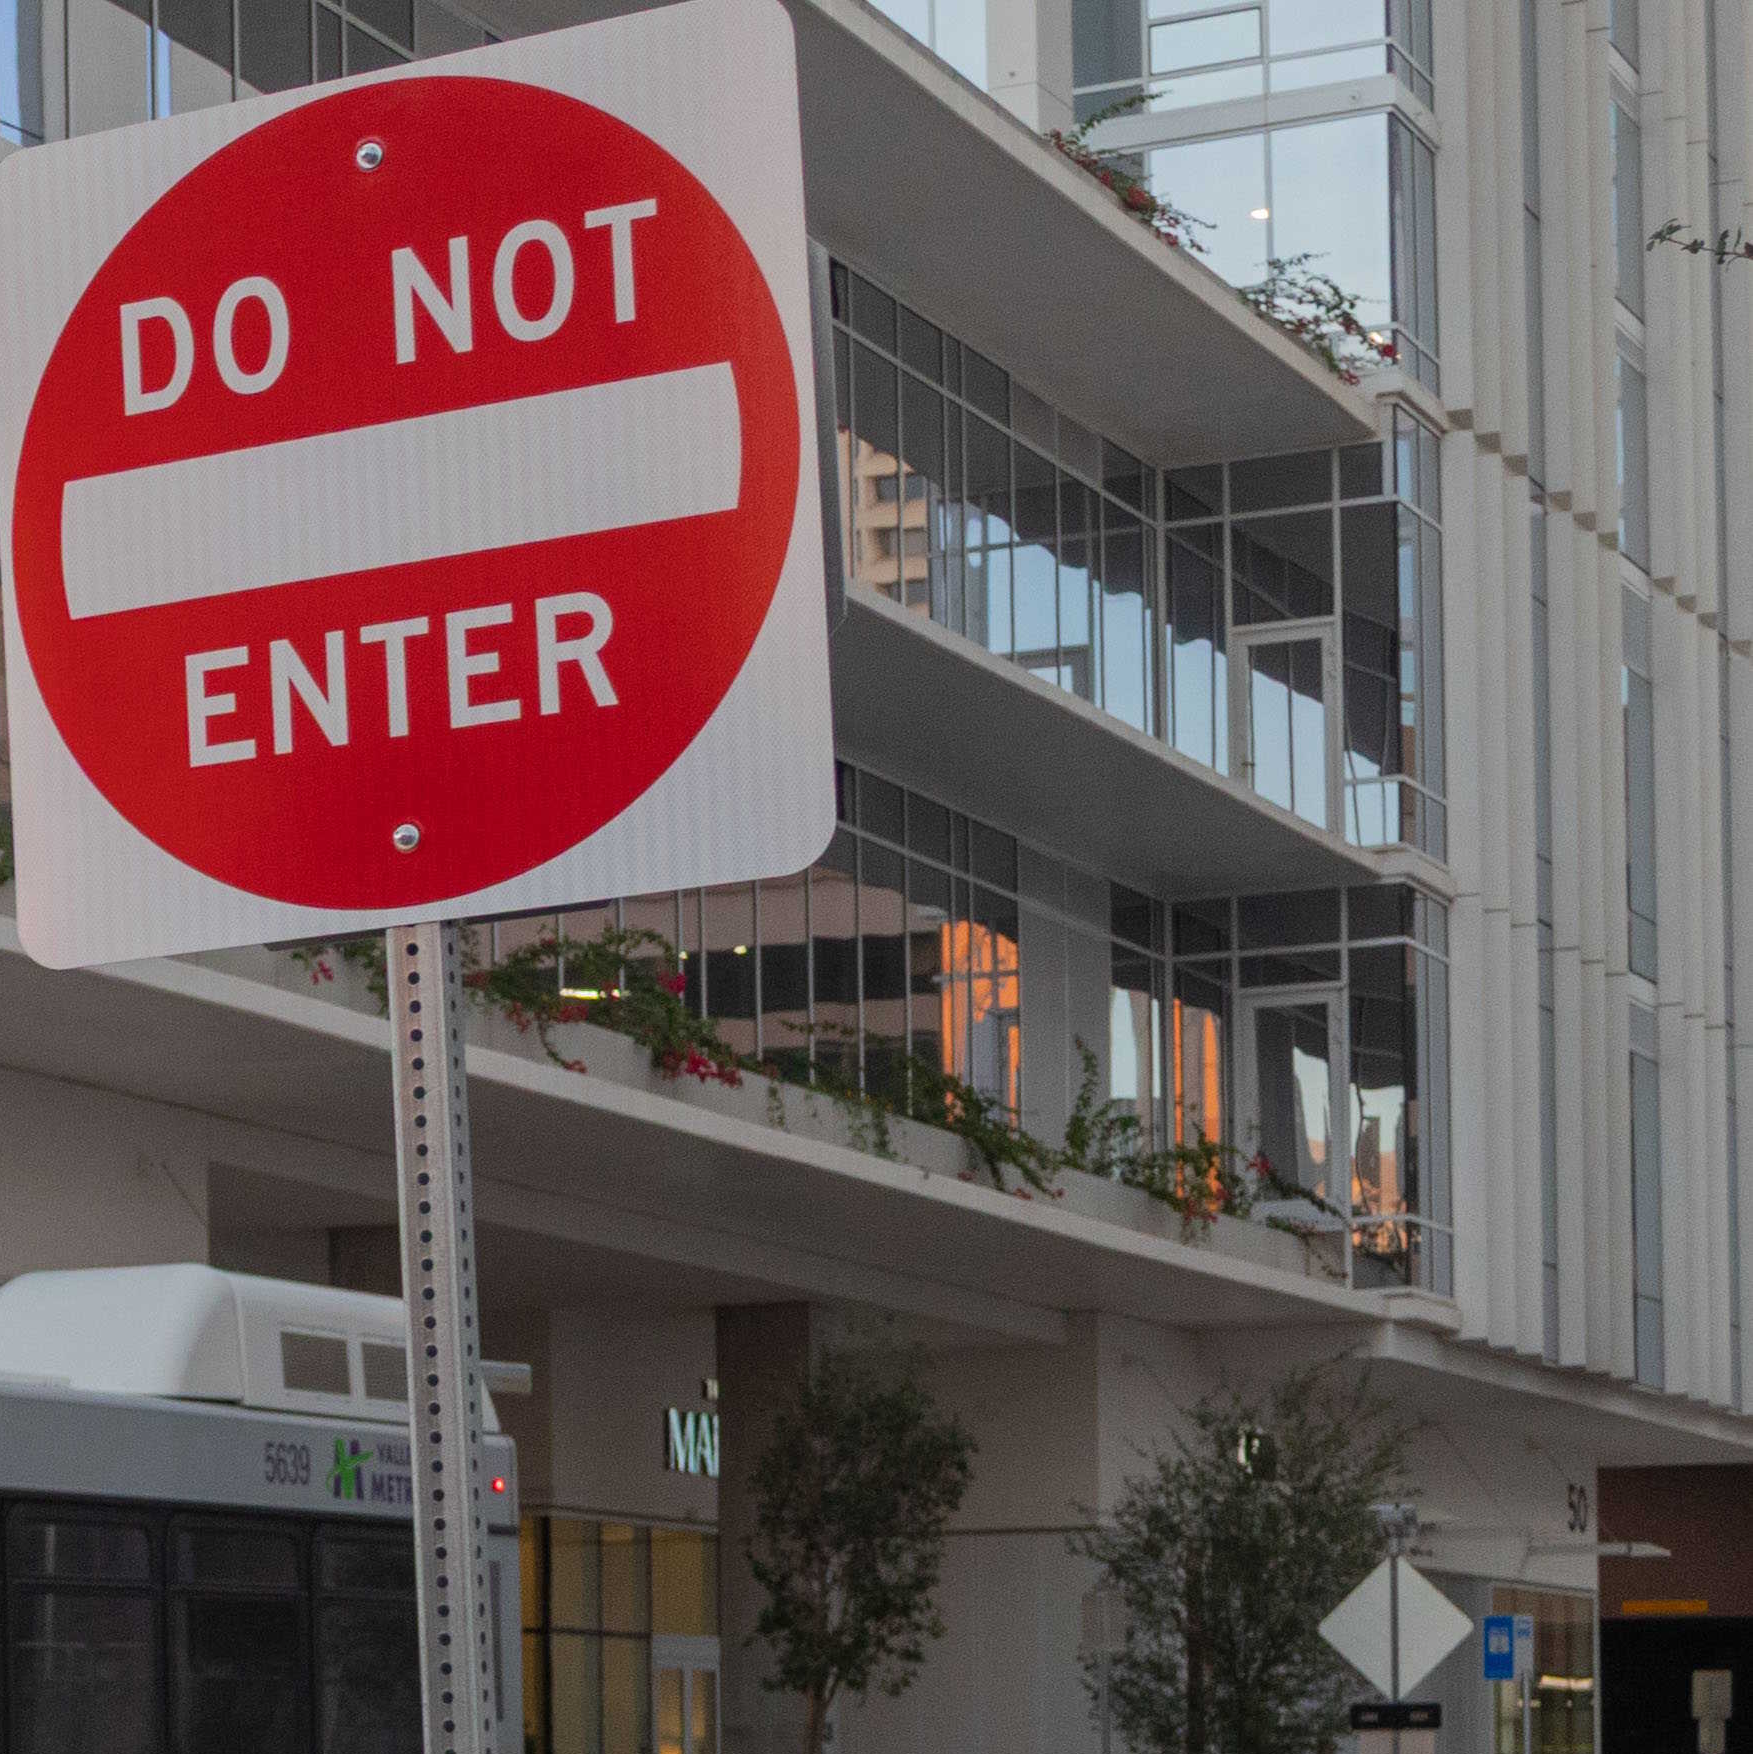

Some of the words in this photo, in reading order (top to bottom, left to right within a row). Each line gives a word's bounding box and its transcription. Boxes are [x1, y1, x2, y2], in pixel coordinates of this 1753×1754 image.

[119, 275, 290, 417] DO
[390, 198, 658, 365] NOT
[184, 591, 619, 769] ENTER
[264, 1441, 311, 1486] 5639
